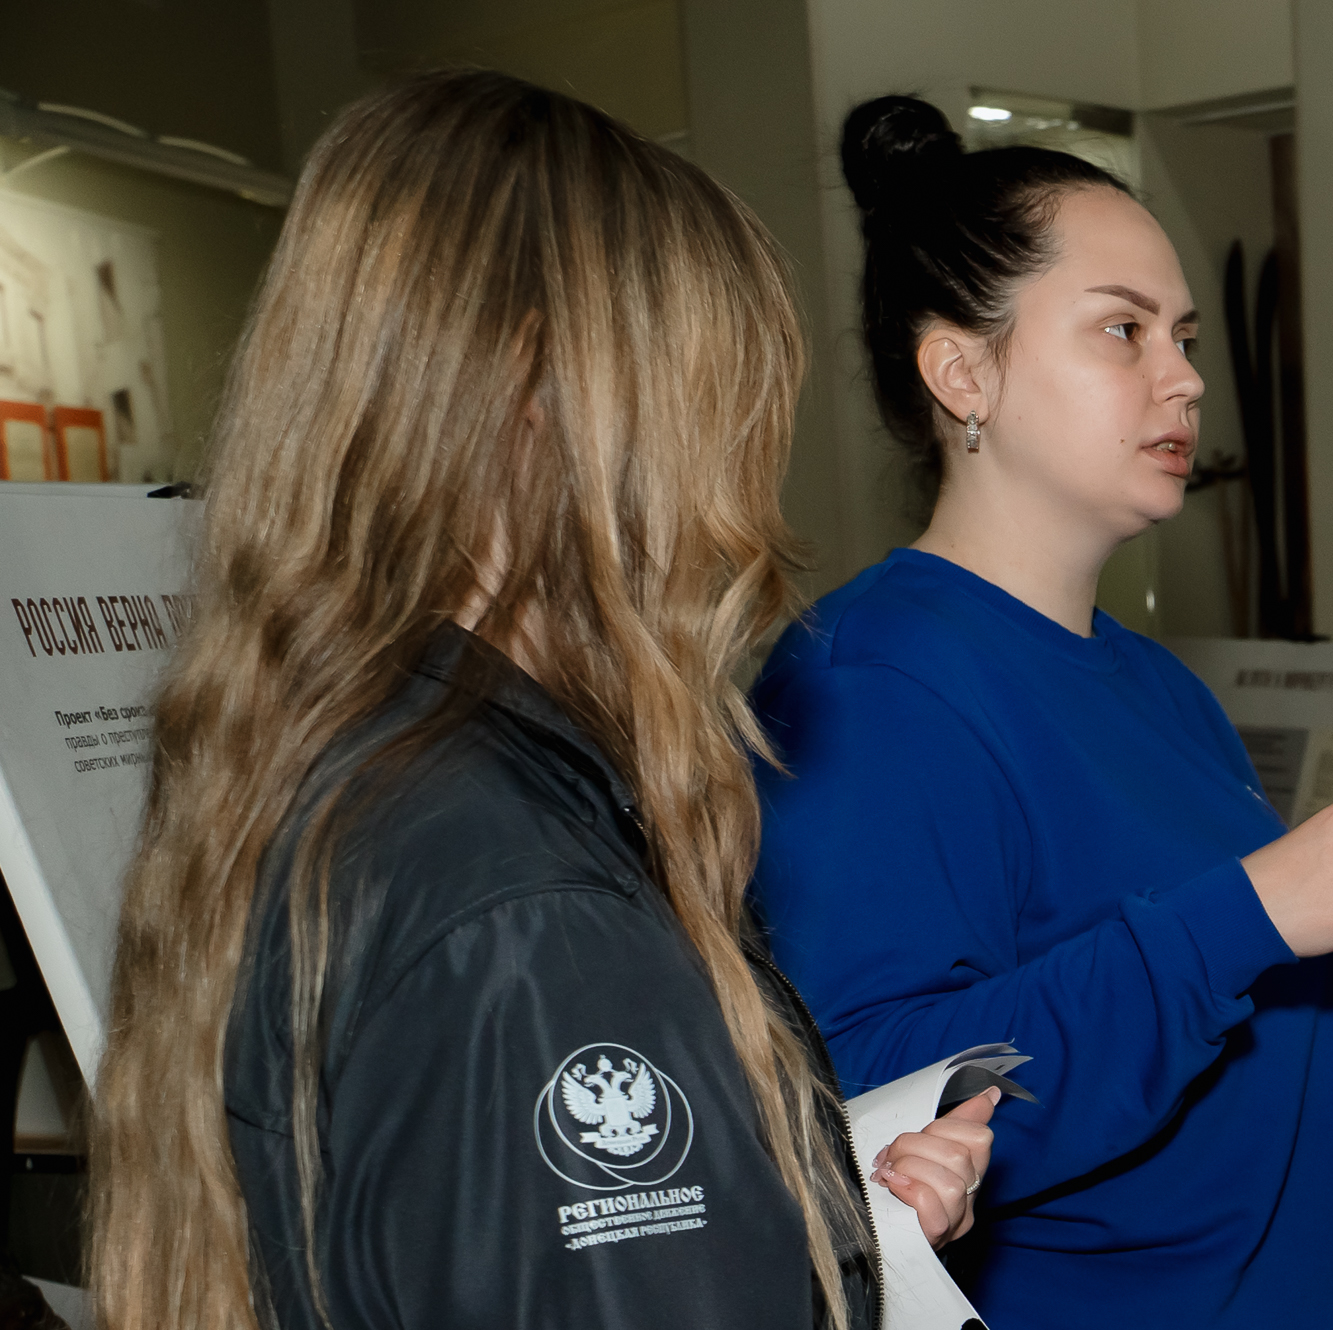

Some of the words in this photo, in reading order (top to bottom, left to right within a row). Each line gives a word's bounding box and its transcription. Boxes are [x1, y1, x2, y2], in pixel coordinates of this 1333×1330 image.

[11, 596, 104, 657] РОССИЯ
[96, 594, 169, 651] ВЕРНА
[54, 709, 94, 729] Проект
[94, 706, 119, 722] «Без
[65, 731, 100, 752] правды
[102, 734, 108, 745] о
[109, 728, 152, 747] преступле
[74, 757, 120, 773] советских
[557, 1185, 704, 1224] РЕГИОНАЛЬНОЕ
[561, 1211, 653, 1236] ОБЩЕСТВЕННОЕ
